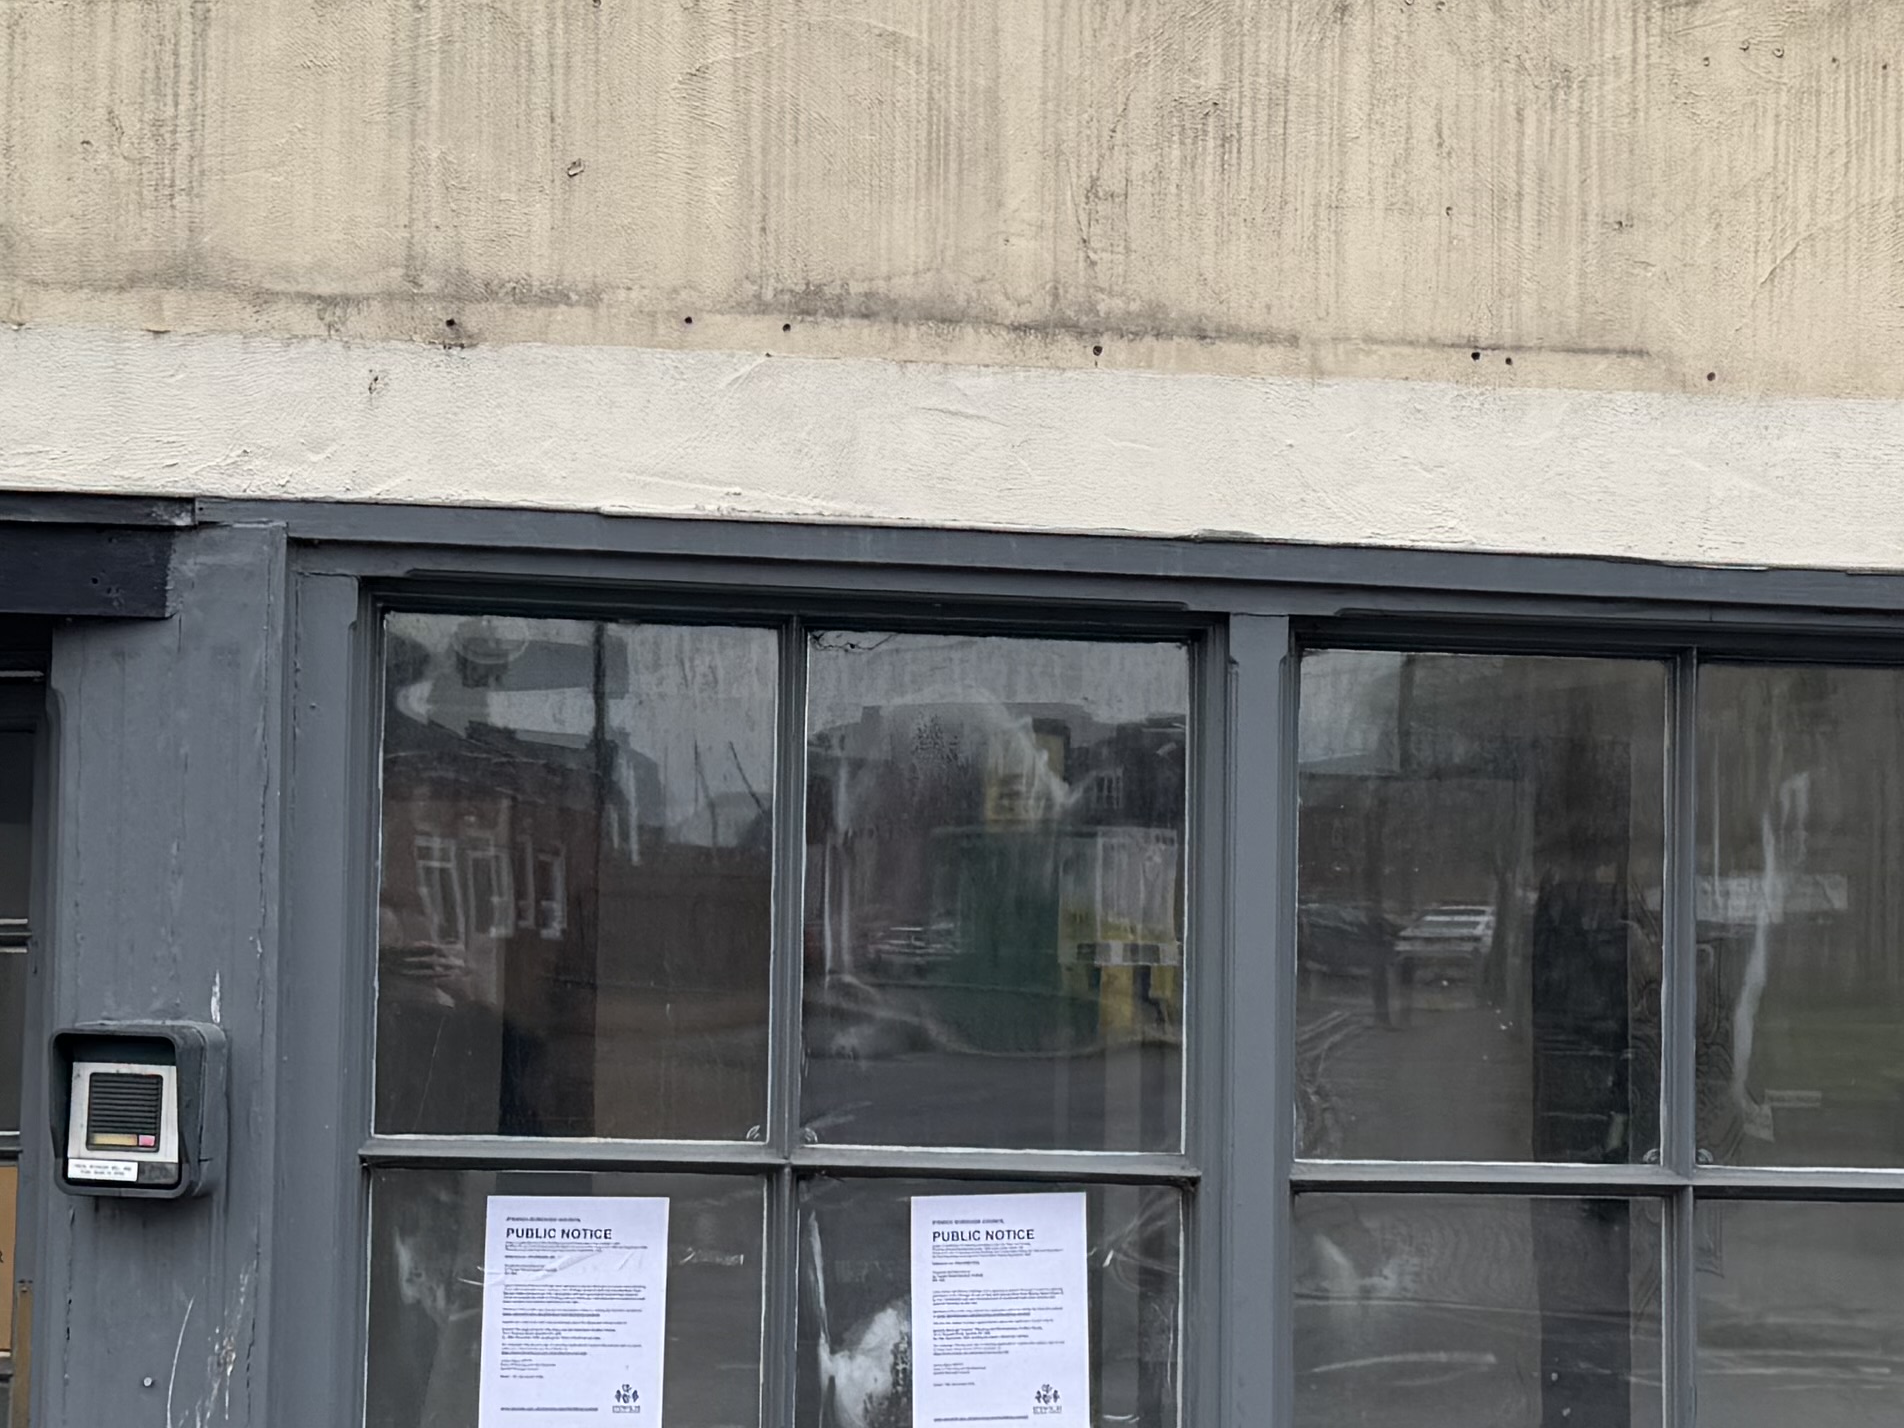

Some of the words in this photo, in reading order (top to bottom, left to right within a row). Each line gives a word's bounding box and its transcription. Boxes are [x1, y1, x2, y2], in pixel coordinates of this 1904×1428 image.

[506, 1227, 556, 1240] PUBLIC
[561, 1228, 612, 1240] NOTICE
[932, 1230, 981, 1242] PUBLIC
[985, 1229, 1035, 1241] NOTICE
